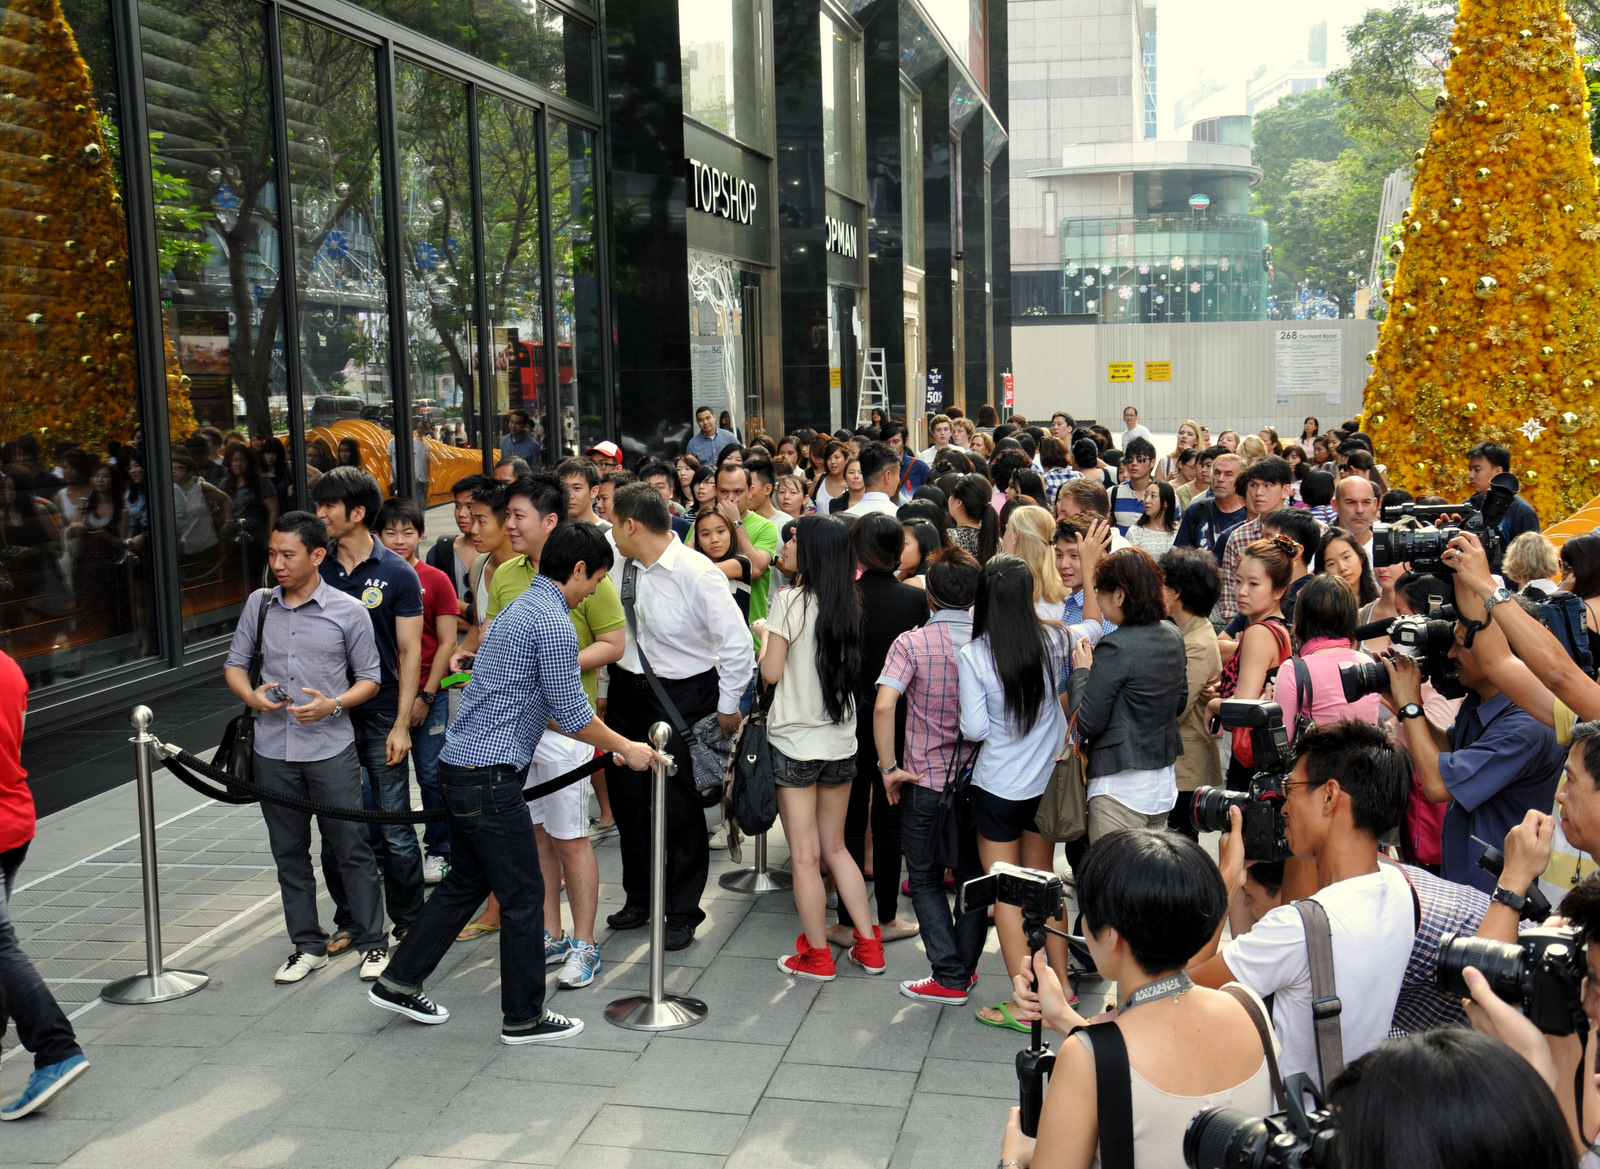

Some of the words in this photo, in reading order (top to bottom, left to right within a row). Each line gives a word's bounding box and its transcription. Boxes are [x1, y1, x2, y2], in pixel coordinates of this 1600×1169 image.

[690, 158, 757, 226] TOPSHOP
[825, 214, 857, 259] OPMAN
[1280, 331, 1298, 340] 268
[1135, 982, 1181, 1002] GALACTICA
